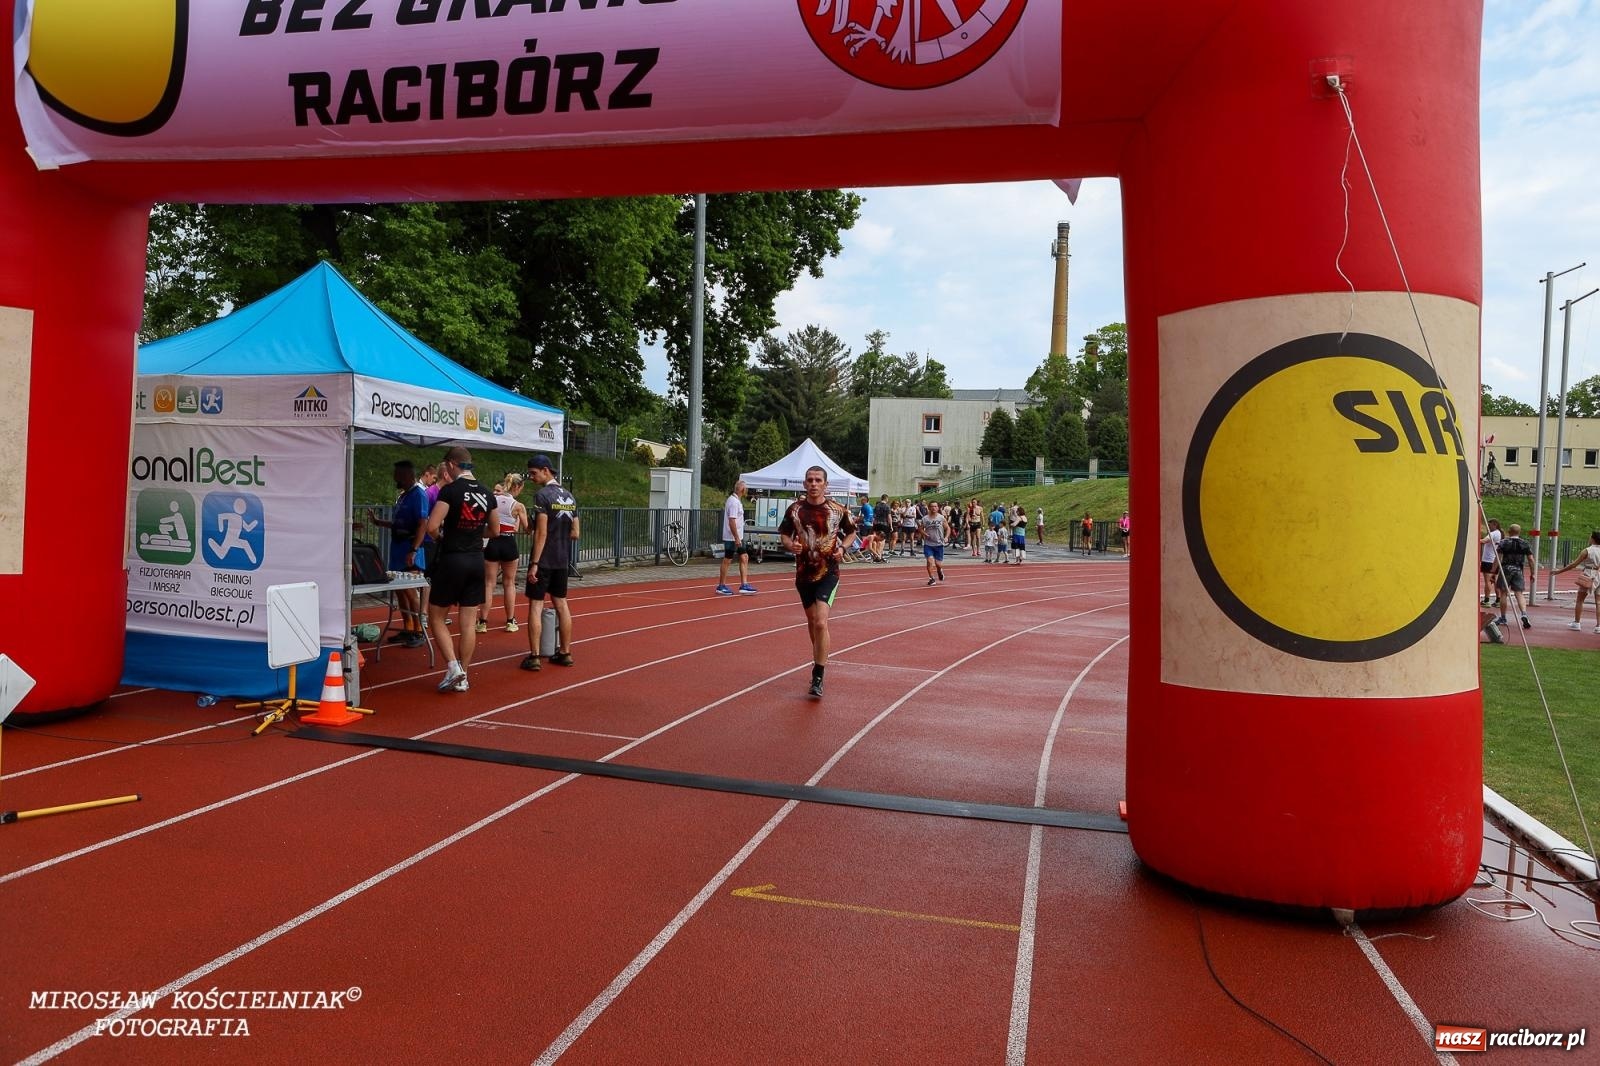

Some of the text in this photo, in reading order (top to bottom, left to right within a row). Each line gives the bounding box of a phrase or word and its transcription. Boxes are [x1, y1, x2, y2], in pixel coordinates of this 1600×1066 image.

[239, 0, 374, 37] BEZ
[288, 38, 661, 127] RACIBÓRZ
[294, 399, 328, 412] MITKO
[371, 392, 460, 426] PersonalBest
[1333, 390, 1463, 455] SIR
[131, 447, 266, 486] onalBest
[210, 587, 253, 600] BIEGOWE
[213, 573, 252, 585] TRENINGI
